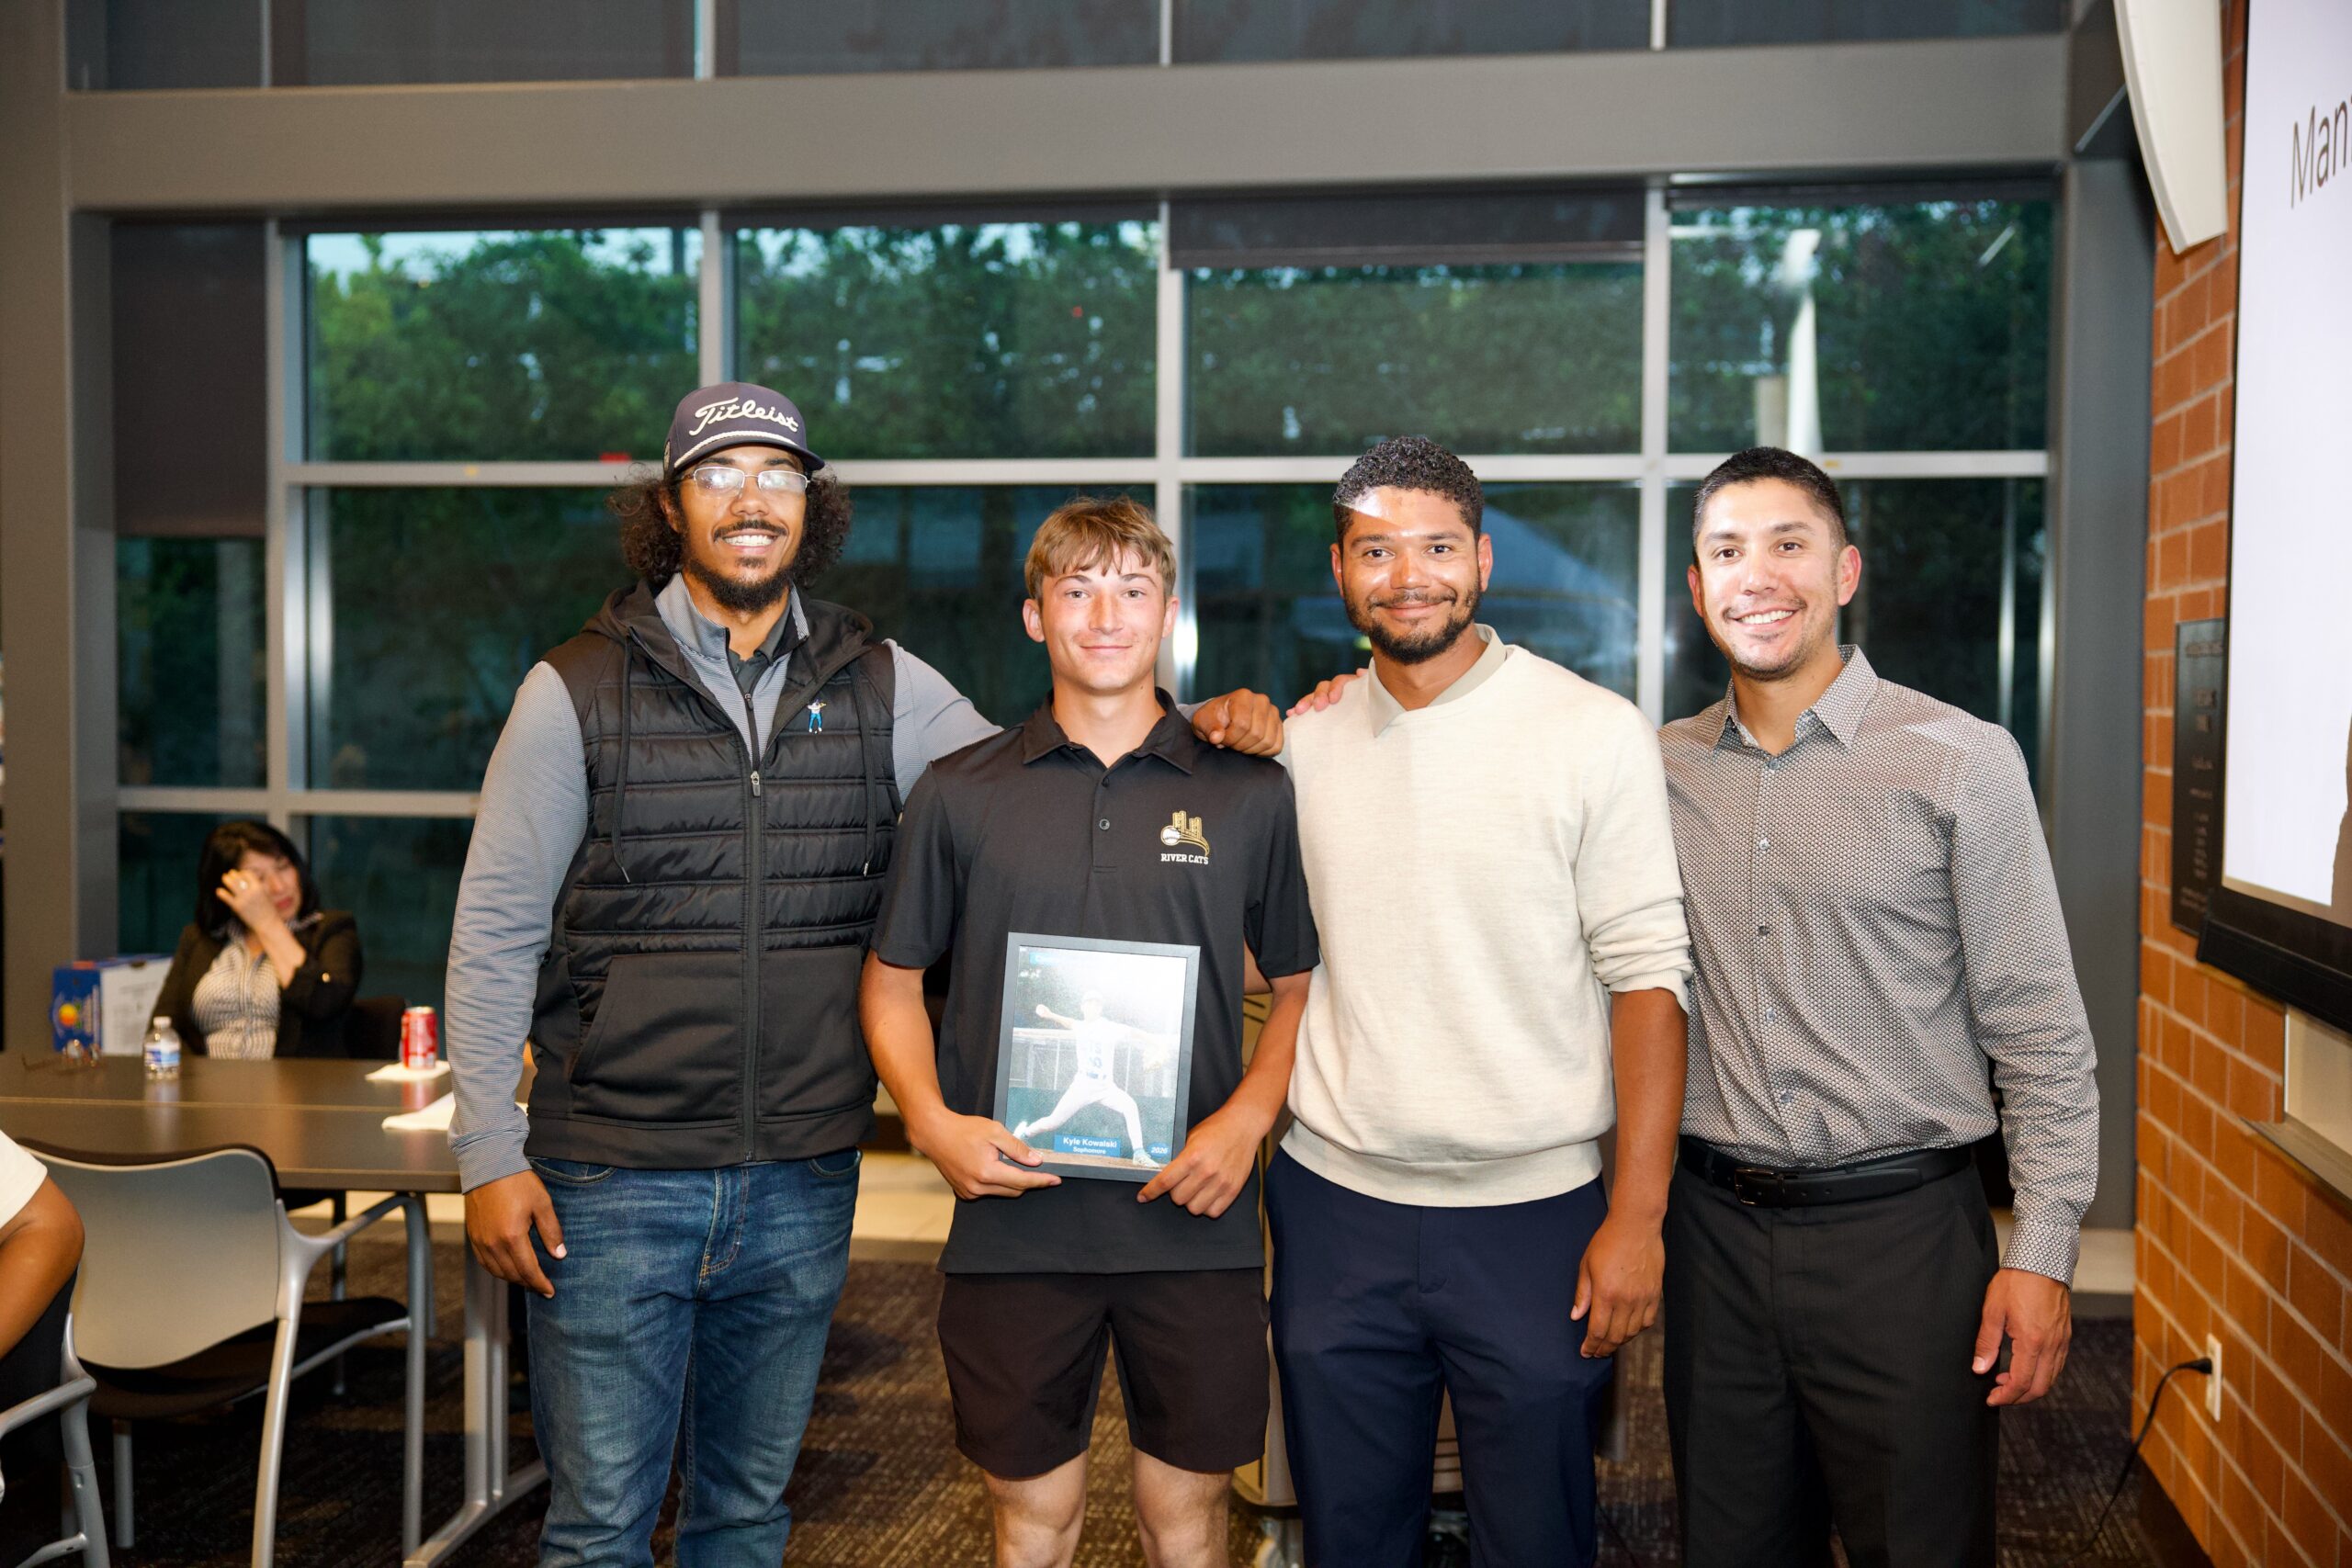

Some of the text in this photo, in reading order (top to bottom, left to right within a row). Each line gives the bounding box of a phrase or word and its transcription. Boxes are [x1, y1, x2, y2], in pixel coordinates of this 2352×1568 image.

[2290, 94, 2352, 209] Man
[689, 397, 798, 435] Titleist
[1160, 853, 1209, 864] RIVER CATS
[1063, 1137, 1117, 1148] Kyle Kowalski
[1073, 1146, 1106, 1155] Sophomore
